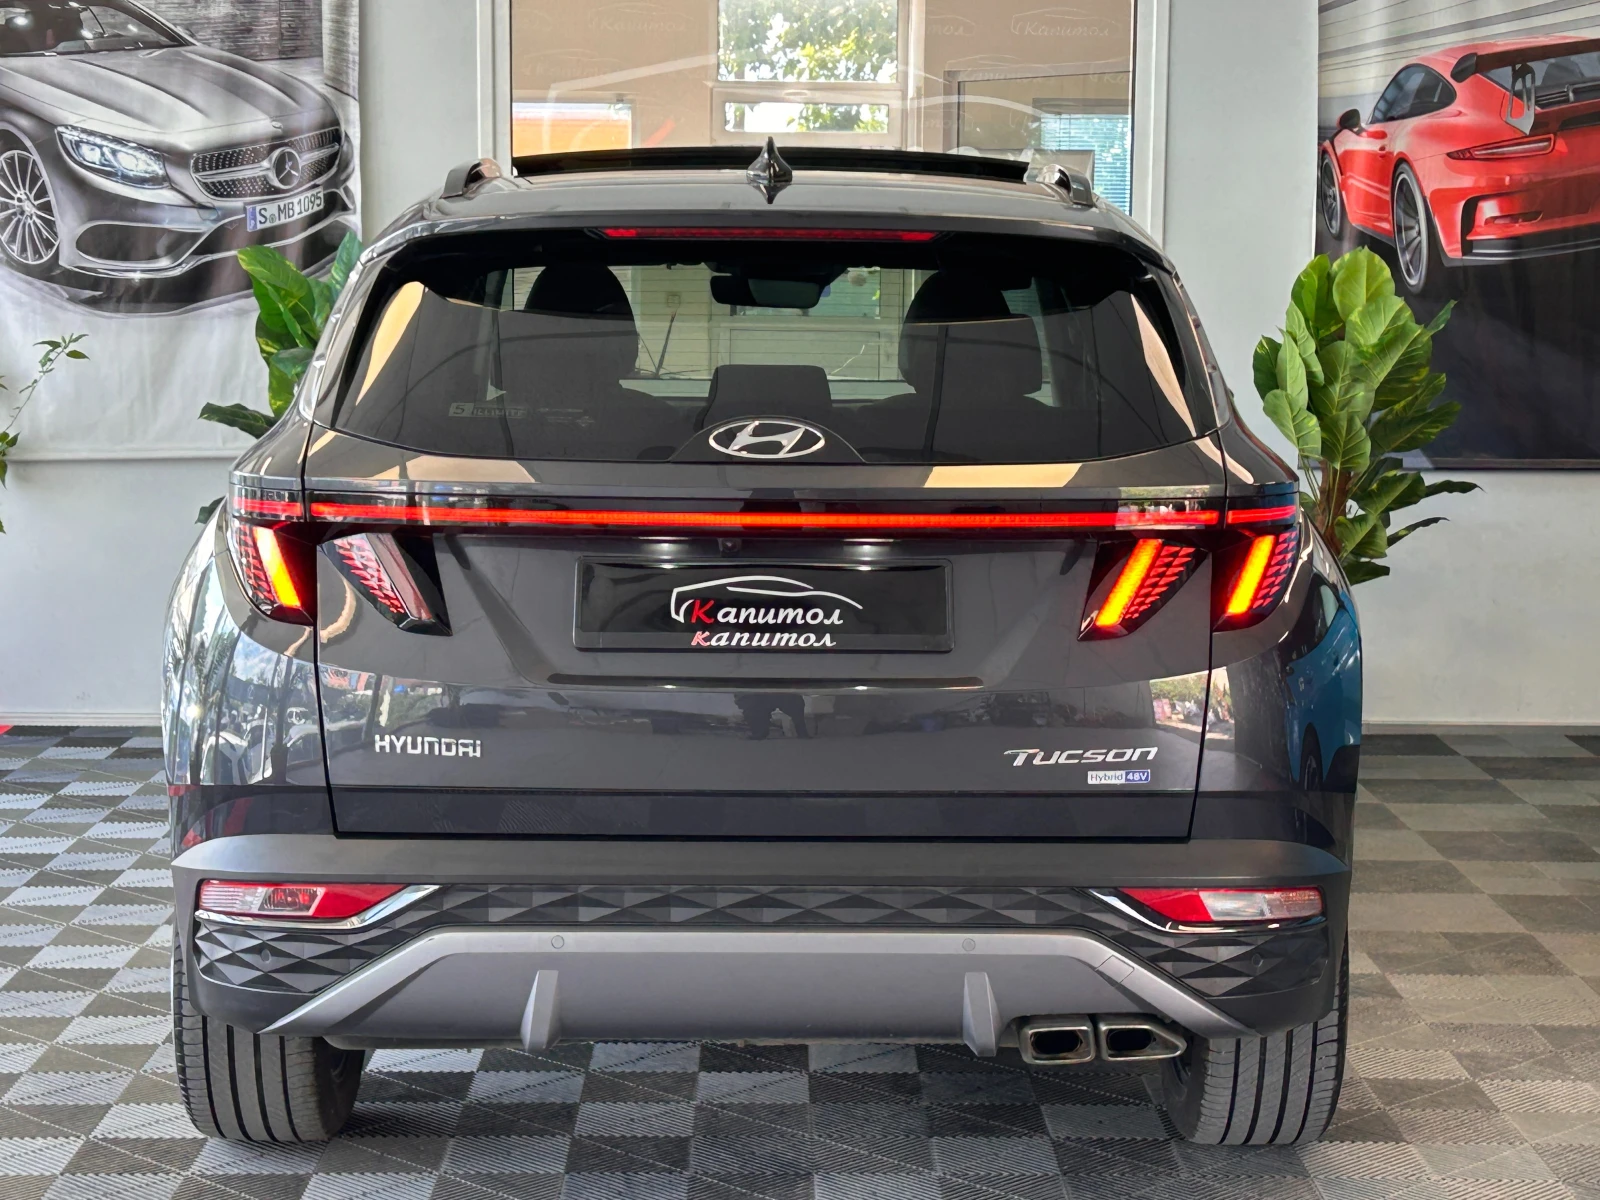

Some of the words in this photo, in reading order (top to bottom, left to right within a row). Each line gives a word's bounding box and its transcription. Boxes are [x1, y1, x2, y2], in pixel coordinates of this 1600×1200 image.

[258, 207, 268, 224] S
[277, 201, 295, 221] MB
[297, 191, 322, 215] 1095
[690, 599, 844, 624] Капитол
[374, 734, 482, 758] HYUNDAI
[1090, 771, 1123, 783] Hybrid
[1126, 771, 1148, 782] 48V
